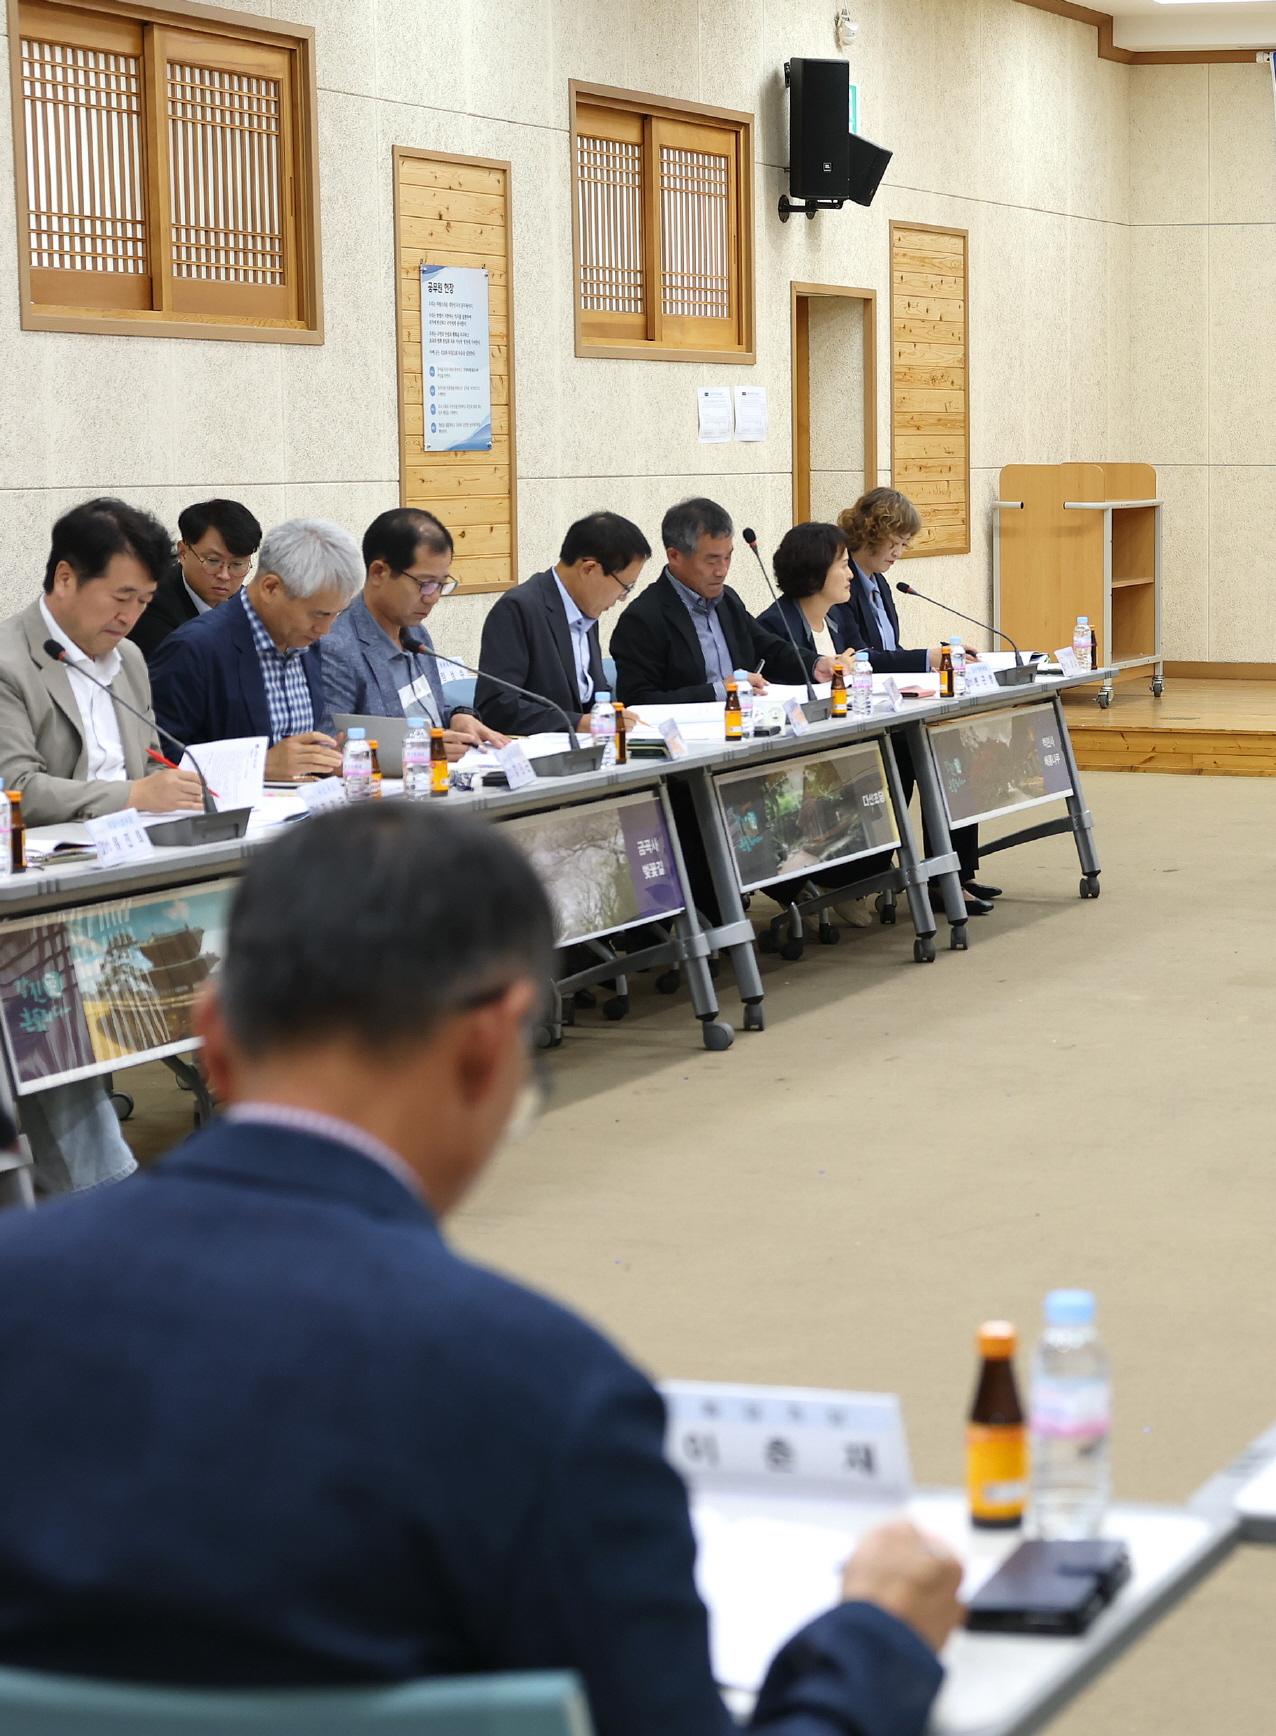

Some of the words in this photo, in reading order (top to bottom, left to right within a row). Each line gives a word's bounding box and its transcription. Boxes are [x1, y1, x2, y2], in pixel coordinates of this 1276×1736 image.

[428, 282, 443, 293] 공무원
[444, 283, 455, 294] 헌장
[862, 790, 886, 806] 다산초당
